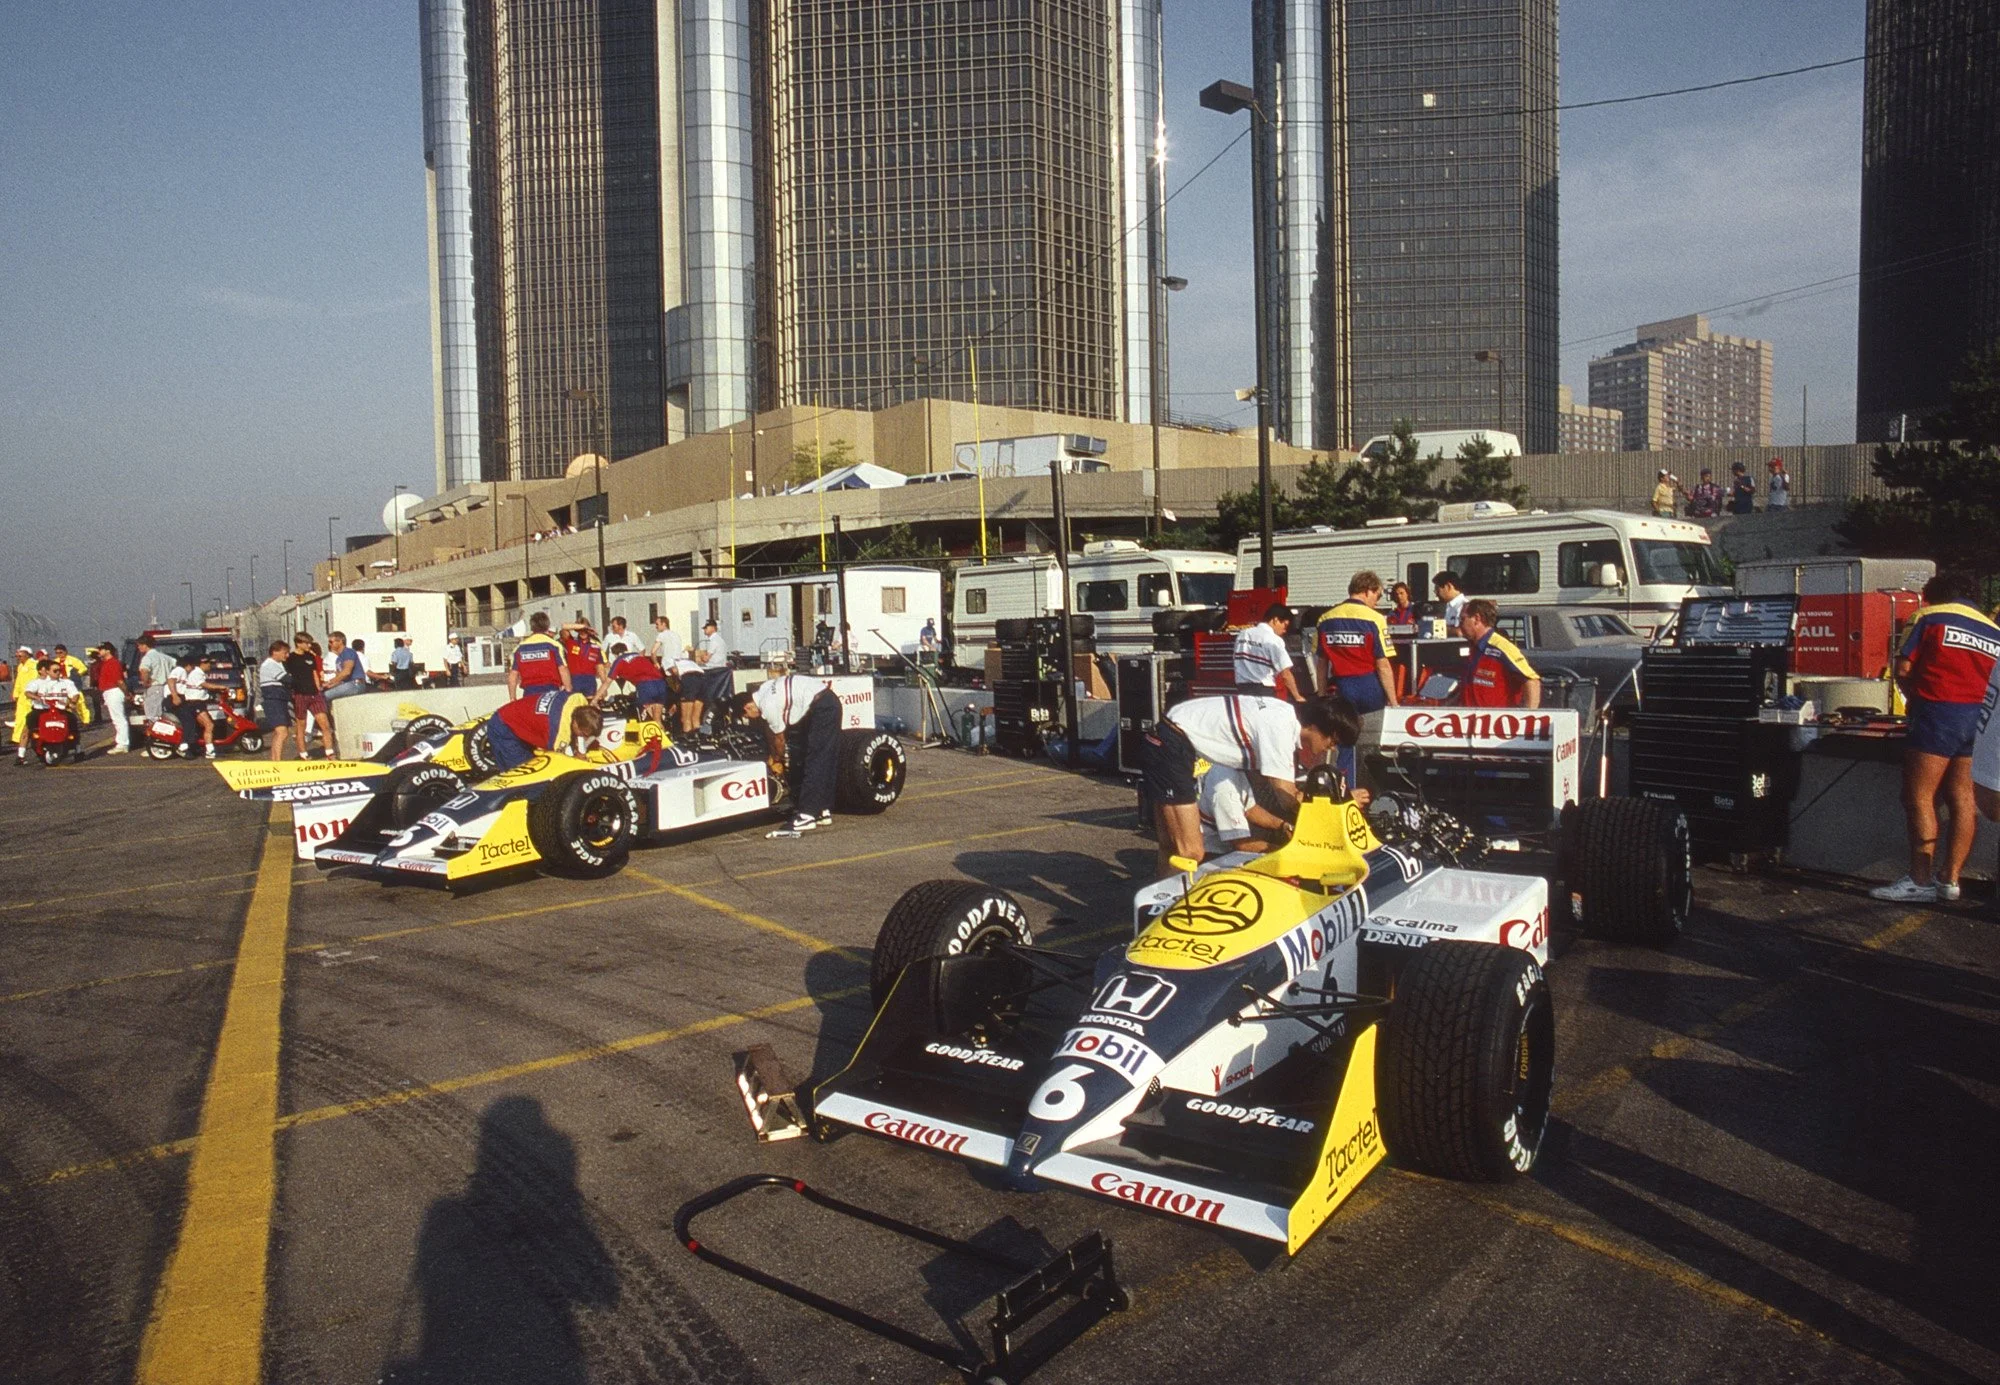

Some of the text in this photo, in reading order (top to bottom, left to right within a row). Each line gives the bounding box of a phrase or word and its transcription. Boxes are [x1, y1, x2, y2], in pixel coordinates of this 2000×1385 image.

[1325, 633, 1365, 646] DENIM
[1799, 626, 1836, 638] AUL
[1946, 630, 2000, 657] DENIM
[521, 651, 550, 661] DENIM
[1404, 712, 1551, 742] Canon
[296, 763, 357, 773] GOODYEAR
[271, 781, 370, 802] HONDA
[1714, 795, 1734, 806] Beta
[582, 776, 639, 836] GOODYEAR
[479, 836, 531, 861] Tactel
[1298, 839, 1322, 849] Nelson
[1195, 888, 1249, 910] ICI
[1394, 917, 1459, 933] calma
[1078, 1014, 1145, 1037] HONDA
[924, 1042, 1025, 1071] GOODYEAR
[1058, 1030, 1149, 1076] Mobil
[1028, 1063, 1096, 1122] 6
[1186, 1098, 1315, 1134] GOODYEAR
[864, 1112, 969, 1154] Canon
[1325, 1107, 1378, 1188] Tactel
[1091, 1172, 1226, 1224] Canon
